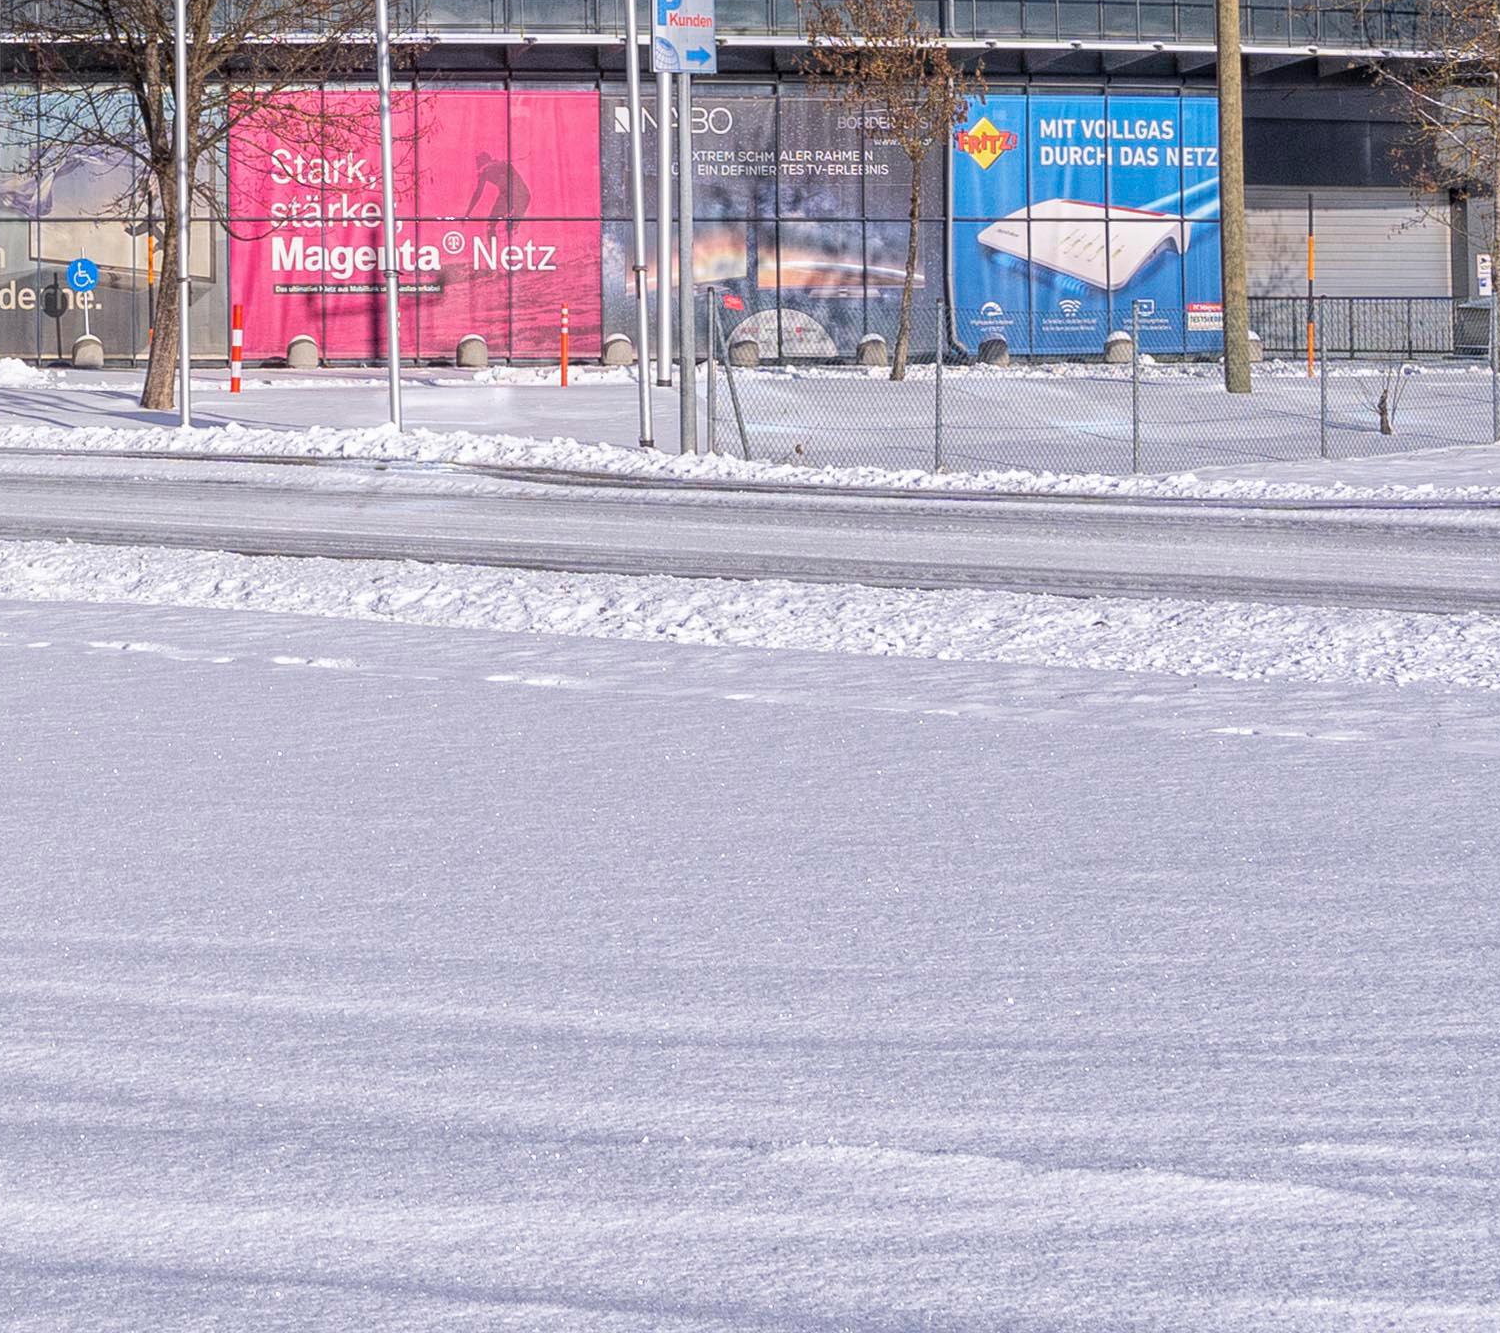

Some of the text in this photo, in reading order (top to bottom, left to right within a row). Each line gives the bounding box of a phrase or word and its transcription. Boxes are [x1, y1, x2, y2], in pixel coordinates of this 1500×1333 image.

[669, 13, 713, 28] Kunden
[1040, 119, 1175, 139] MIT VOLLGAS
[692, 150, 735, 162] XTREM
[815, 150, 874, 162] RAHMEN
[1040, 146, 1219, 166] DURCH DAS NETZ
[271, 148, 377, 189] Stark,
[697, 164, 718, 176] EIN
[807, 164, 890, 176] TV-ERLEBNIS
[270, 194, 404, 233] stärke,
[271, 236, 441, 279] Magenta
[472, 236, 557, 271] Netz
